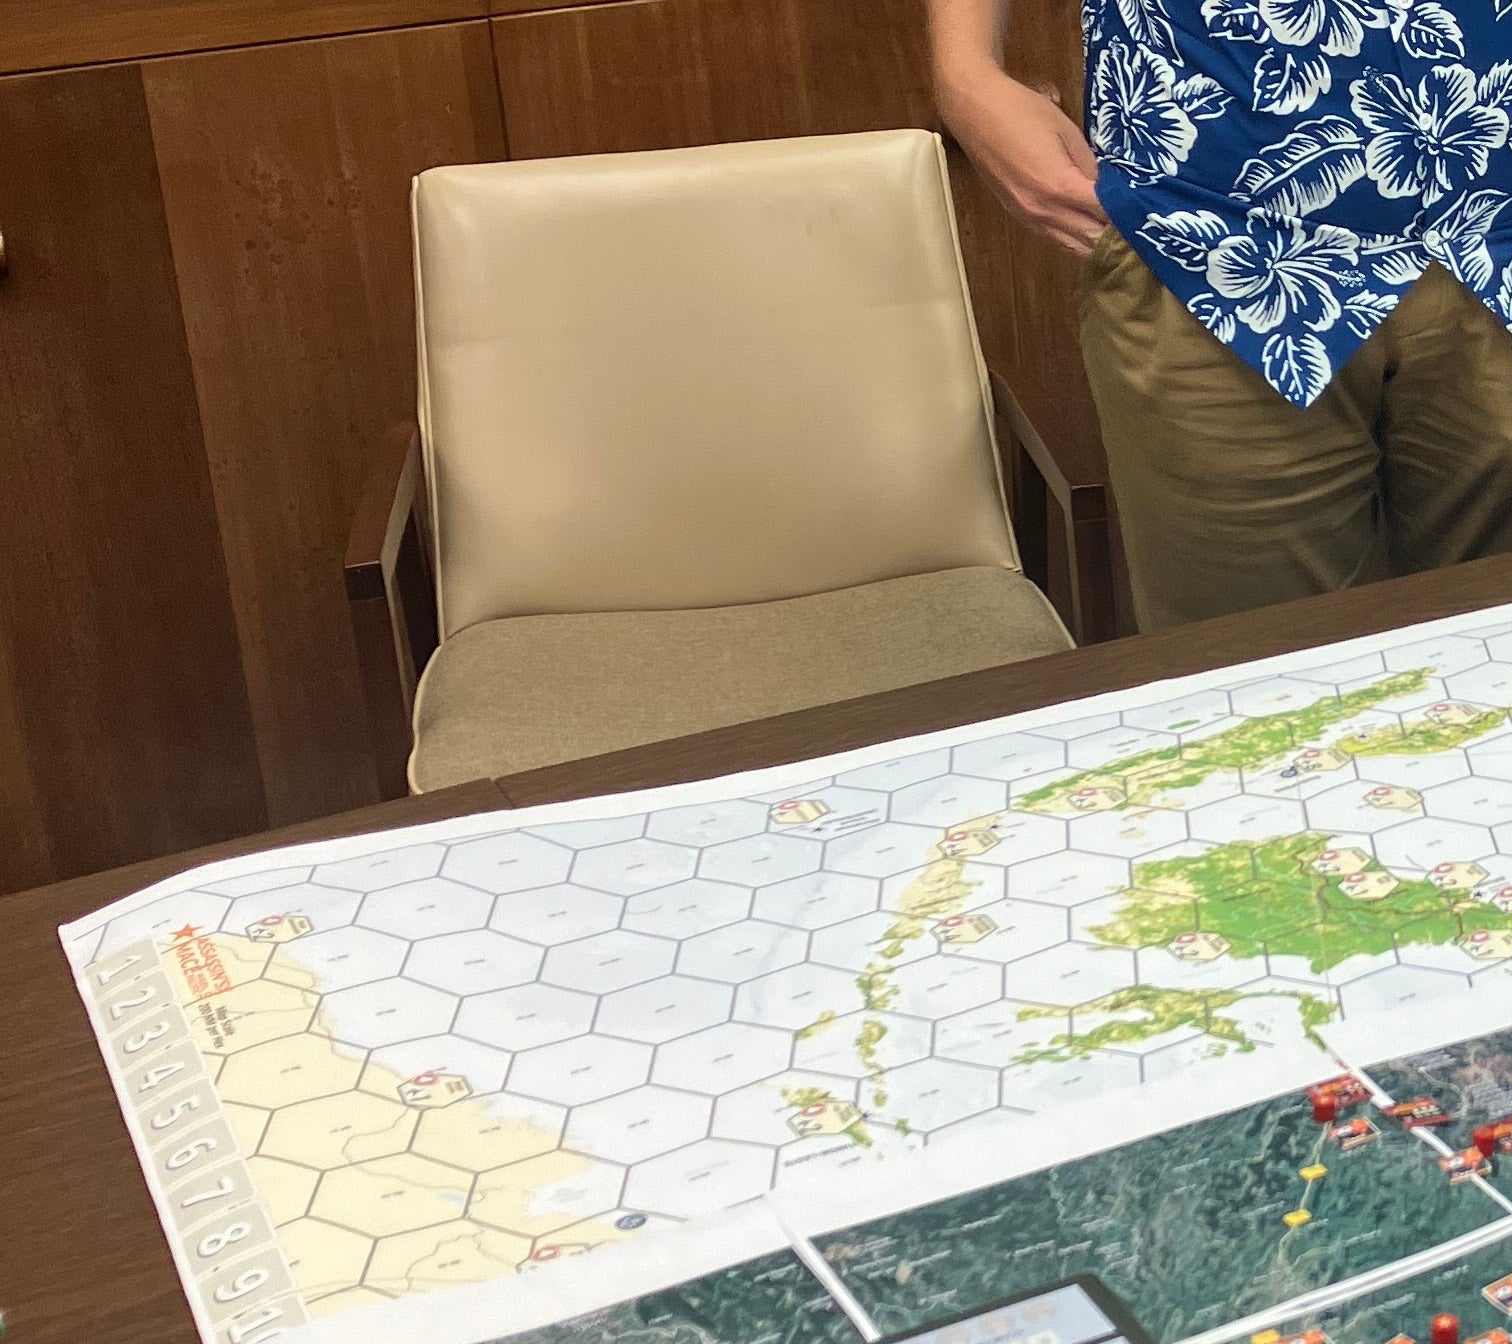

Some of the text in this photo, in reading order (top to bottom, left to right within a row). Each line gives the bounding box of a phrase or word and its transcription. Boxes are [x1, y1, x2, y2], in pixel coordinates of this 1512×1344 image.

[97, 956, 141, 985] 1
[176, 942, 204, 976] MACE
[198, 937, 233, 992] ASSASSIN'S
[110, 987, 156, 1020] 2
[123, 1021, 170, 1053] 3
[138, 1061, 185, 1093] 4
[150, 1095, 200, 1129] 5
[165, 1138, 218, 1170] 6
[179, 1176, 235, 1209] 7
[196, 1221, 250, 1258] 8
[213, 1269, 269, 1304] 9
